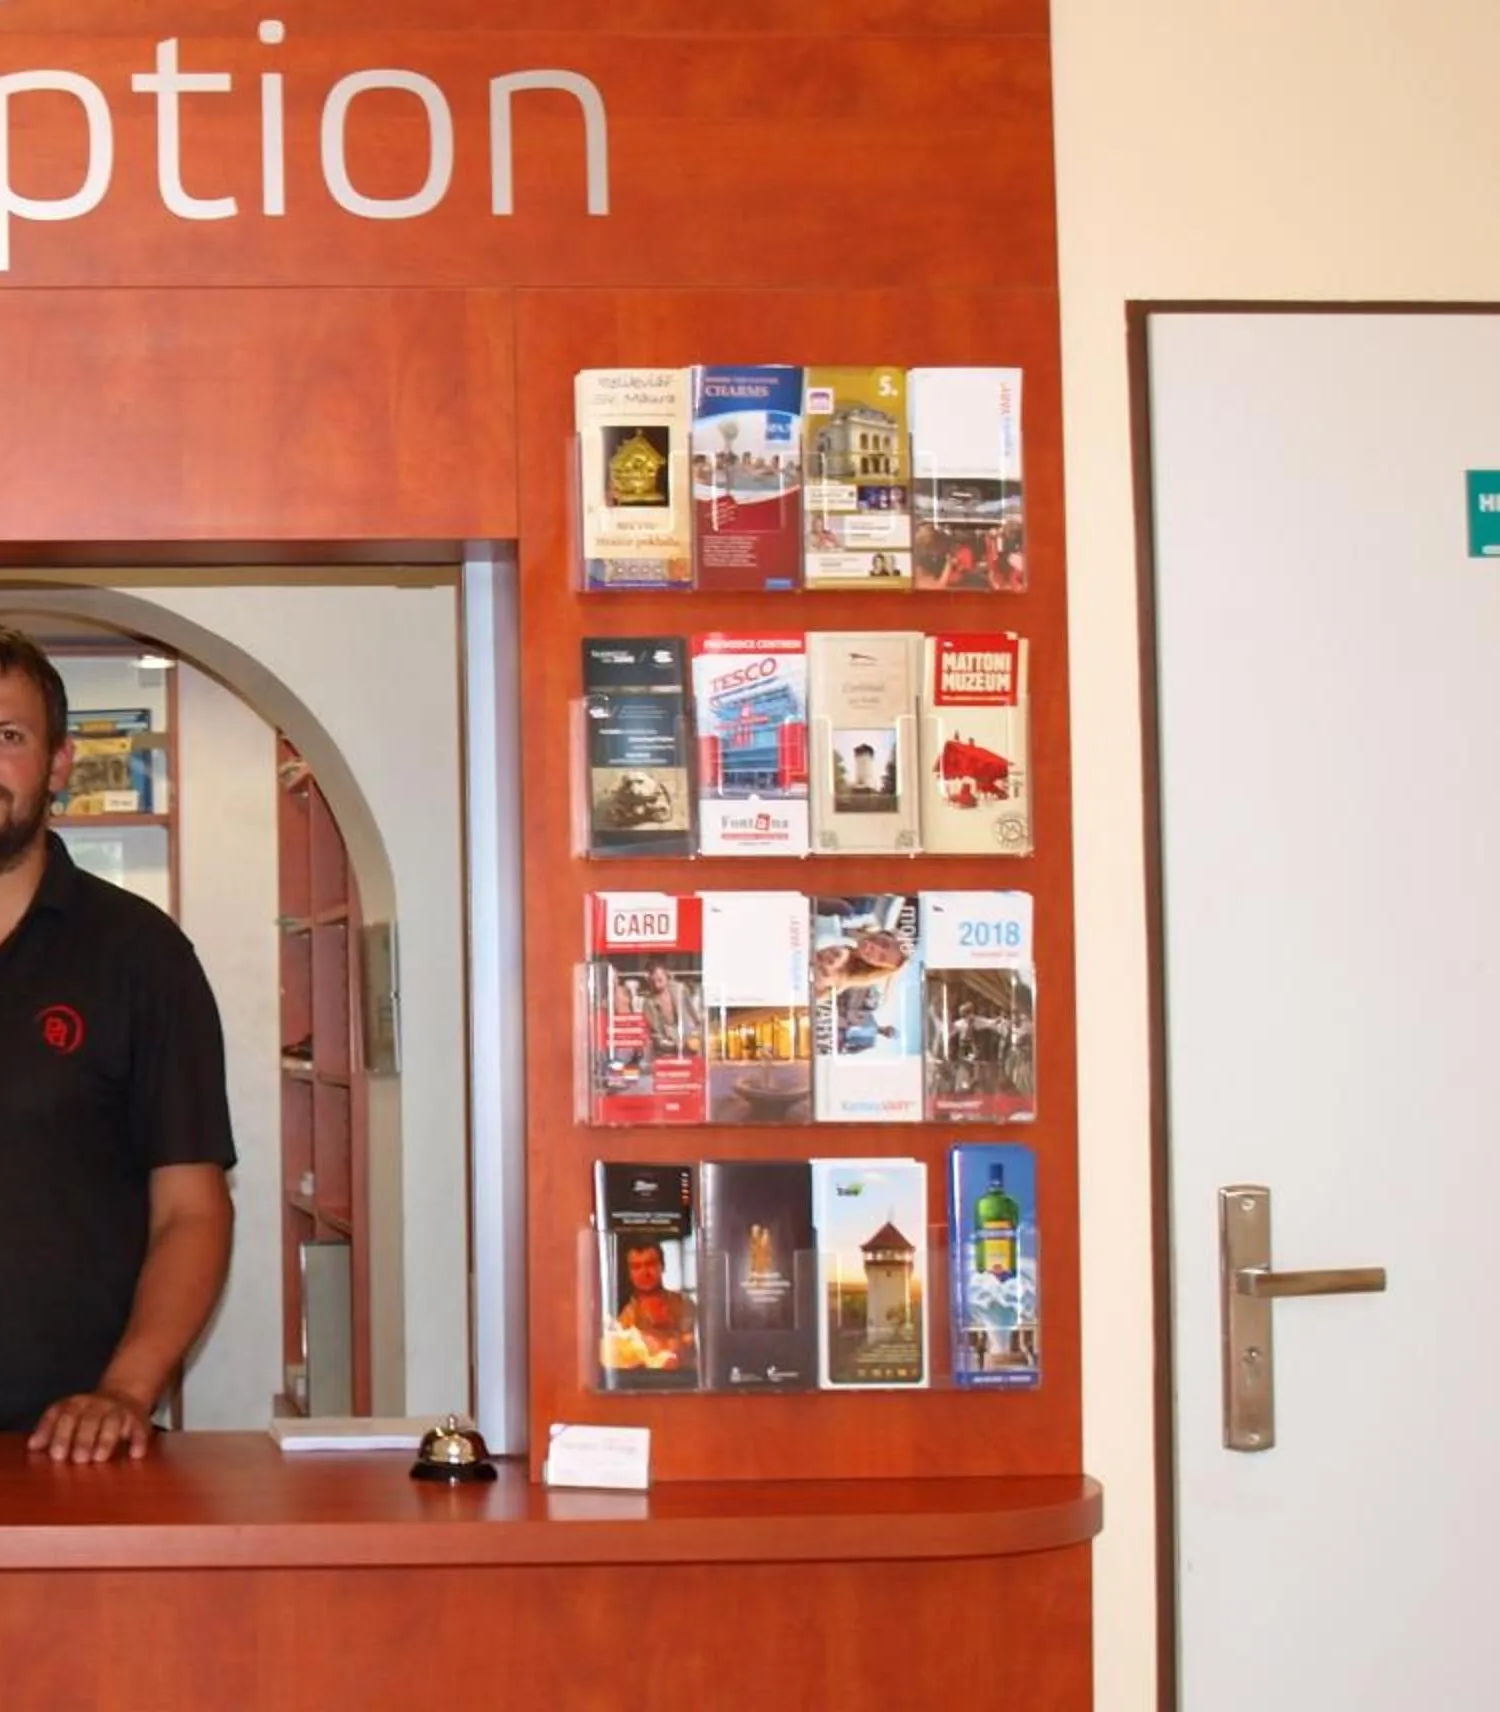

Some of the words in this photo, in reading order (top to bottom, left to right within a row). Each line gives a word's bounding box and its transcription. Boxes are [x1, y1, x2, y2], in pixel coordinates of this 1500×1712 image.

[704, 384, 770, 398] CHARMS
[942, 653, 1012, 672] MATTONI
[710, 656, 778, 694] TESCO
[941, 673, 1011, 692] MUZEUM
[614, 913, 670, 936] CARD
[959, 921, 1022, 947] 2018
